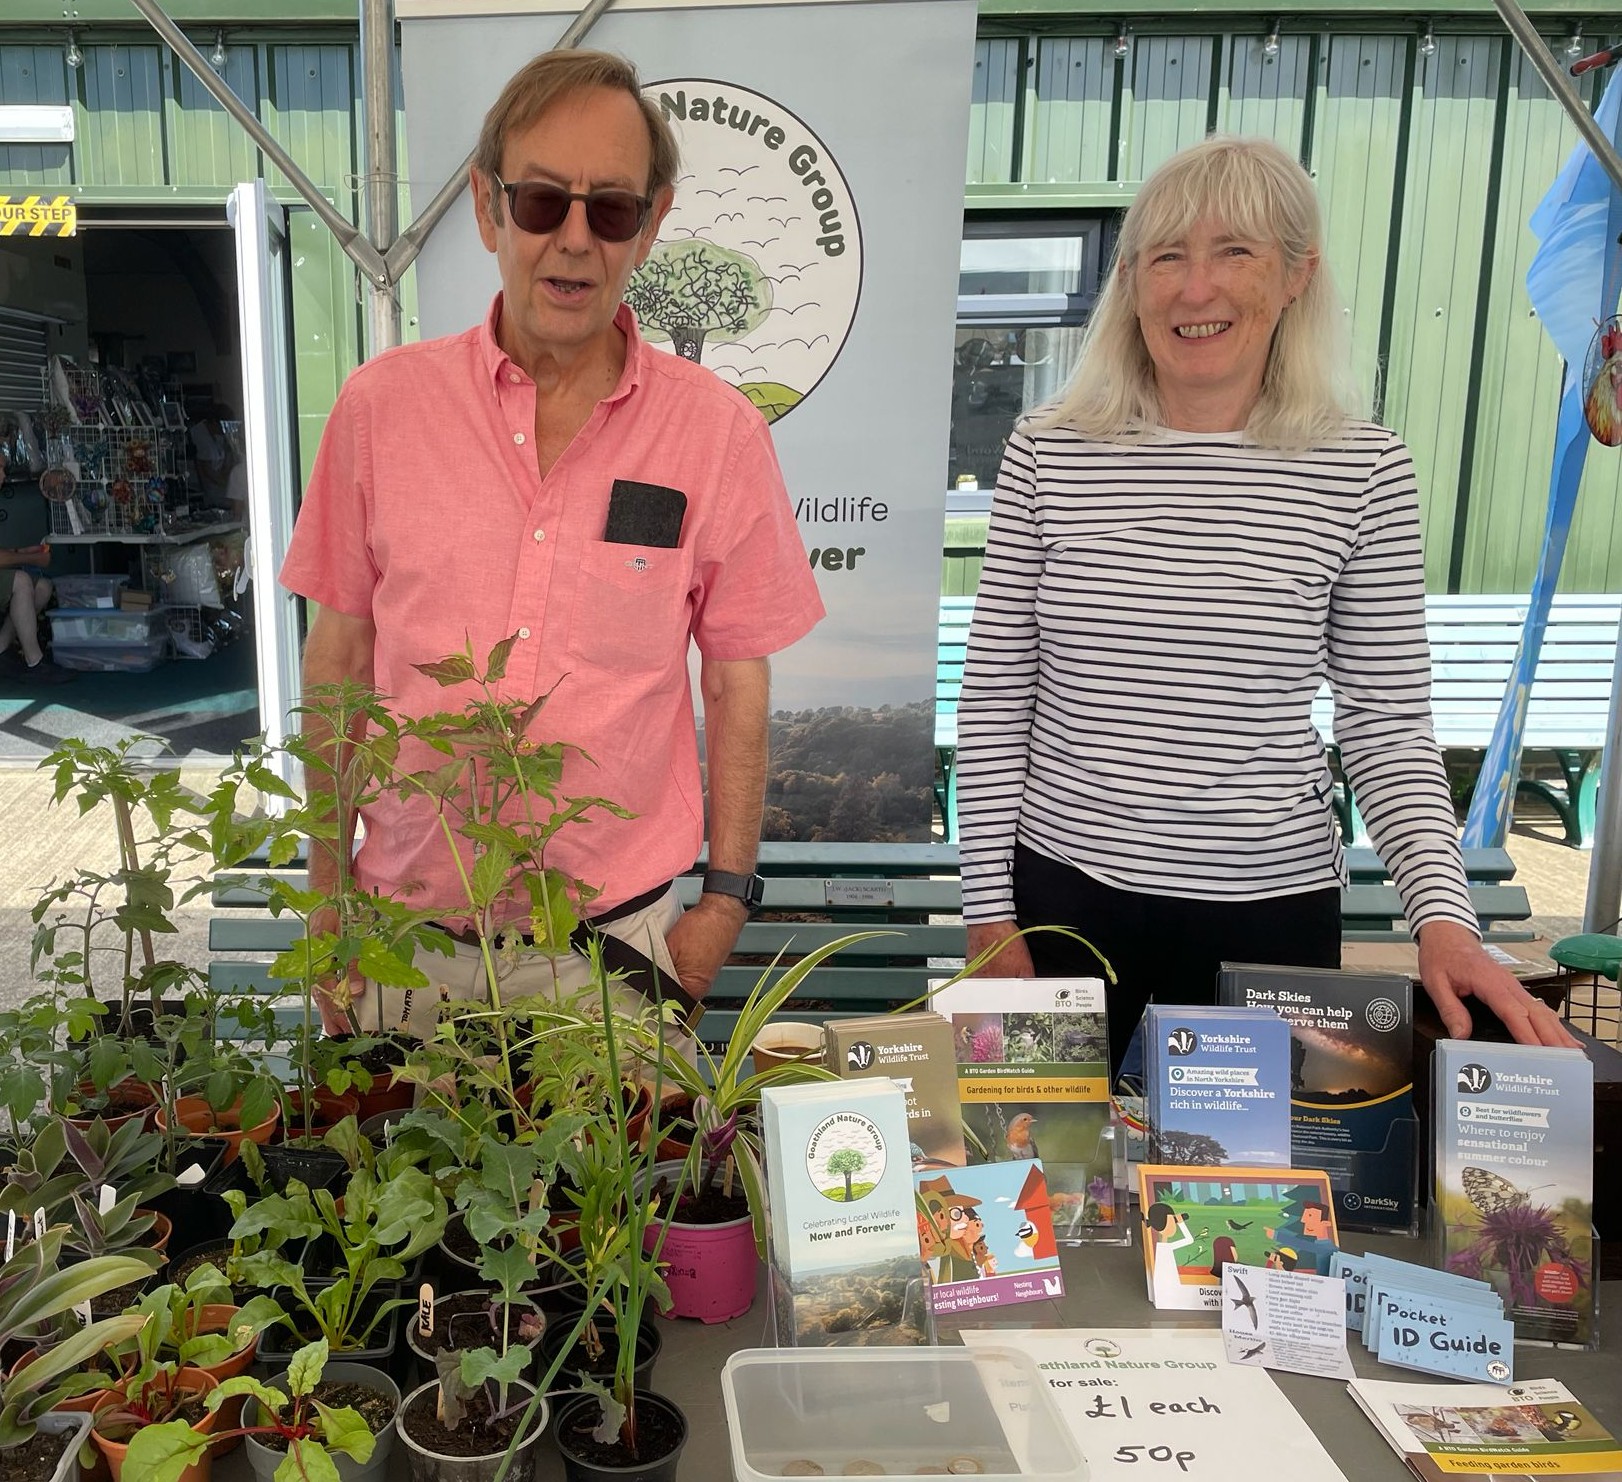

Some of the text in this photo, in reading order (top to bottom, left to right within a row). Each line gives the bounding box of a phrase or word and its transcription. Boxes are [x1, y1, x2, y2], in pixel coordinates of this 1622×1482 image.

[660, 90, 846, 257] Nature Group
[0, 207, 72, 220] UR STEP
[1246, 988, 1311, 1003] Dark Skies
[400, 989, 413, 1024] TOMATO
[1055, 1000, 1072, 1008] BTO
[1277, 1004, 1300, 1017] you
[1302, 1006, 1325, 1016] can
[1326, 1006, 1353, 1020] help
[1316, 1018, 1349, 1030] them
[1200, 1034, 1251, 1044] Yorkshire
[877, 1043, 923, 1055] Yorkshire
[1200, 1044, 1257, 1054] Wildlife Trust
[878, 1053, 930, 1064] Wildlife Trust
[1186, 1068, 1214, 1076] Amazing
[1494, 1072, 1553, 1086] Yorkshire
[966, 1086, 1002, 1094] Gardening
[1064, 1086, 1091, 1094] wildlife
[1170, 1087, 1214, 1097] Discover
[1223, 1088, 1276, 1099] Yorkshire
[1494, 1084, 1560, 1096] Wildlife Trust
[1170, 1100, 1190, 1110] rich
[1192, 1100, 1202, 1110] in
[922, 1108, 931, 1118] in
[1502, 1108, 1542, 1118] wildflowers
[808, 1114, 883, 1160] Goathland Nature Group
[1458, 1124, 1546, 1143] Where to enjoy
[1458, 1138, 1528, 1152] sensational
[1458, 1152, 1549, 1166] summer colour
[1364, 1196, 1399, 1209] DarkSky
[802, 1208, 900, 1231] Celebrating Local Wildlife
[810, 1222, 896, 1242] Now and Forever
[1228, 1266, 1248, 1276] Swift
[1013, 1281, 1033, 1289] Nesting
[940, 1289, 955, 1298] local
[956, 1285, 980, 1296] wildlife
[1015, 1289, 1044, 1298] Neighbours
[957, 1293, 1000, 1308] Neighbours!
[1204, 1298, 1218, 1306] with
[421, 1298, 432, 1332] KALE
[1388, 1302, 1448, 1327] Pocket
[1393, 1326, 1502, 1356] ID Guide
[1037, 1360, 1218, 1371] athland Nature Group
[1049, 1378, 1072, 1388] for
[1078, 1377, 1119, 1388] sale:
[1085, 1394, 1222, 1419] £1 each
[1113, 1445, 1196, 1472] 50p
[1449, 1460, 1561, 1470] Feeding garden birds
